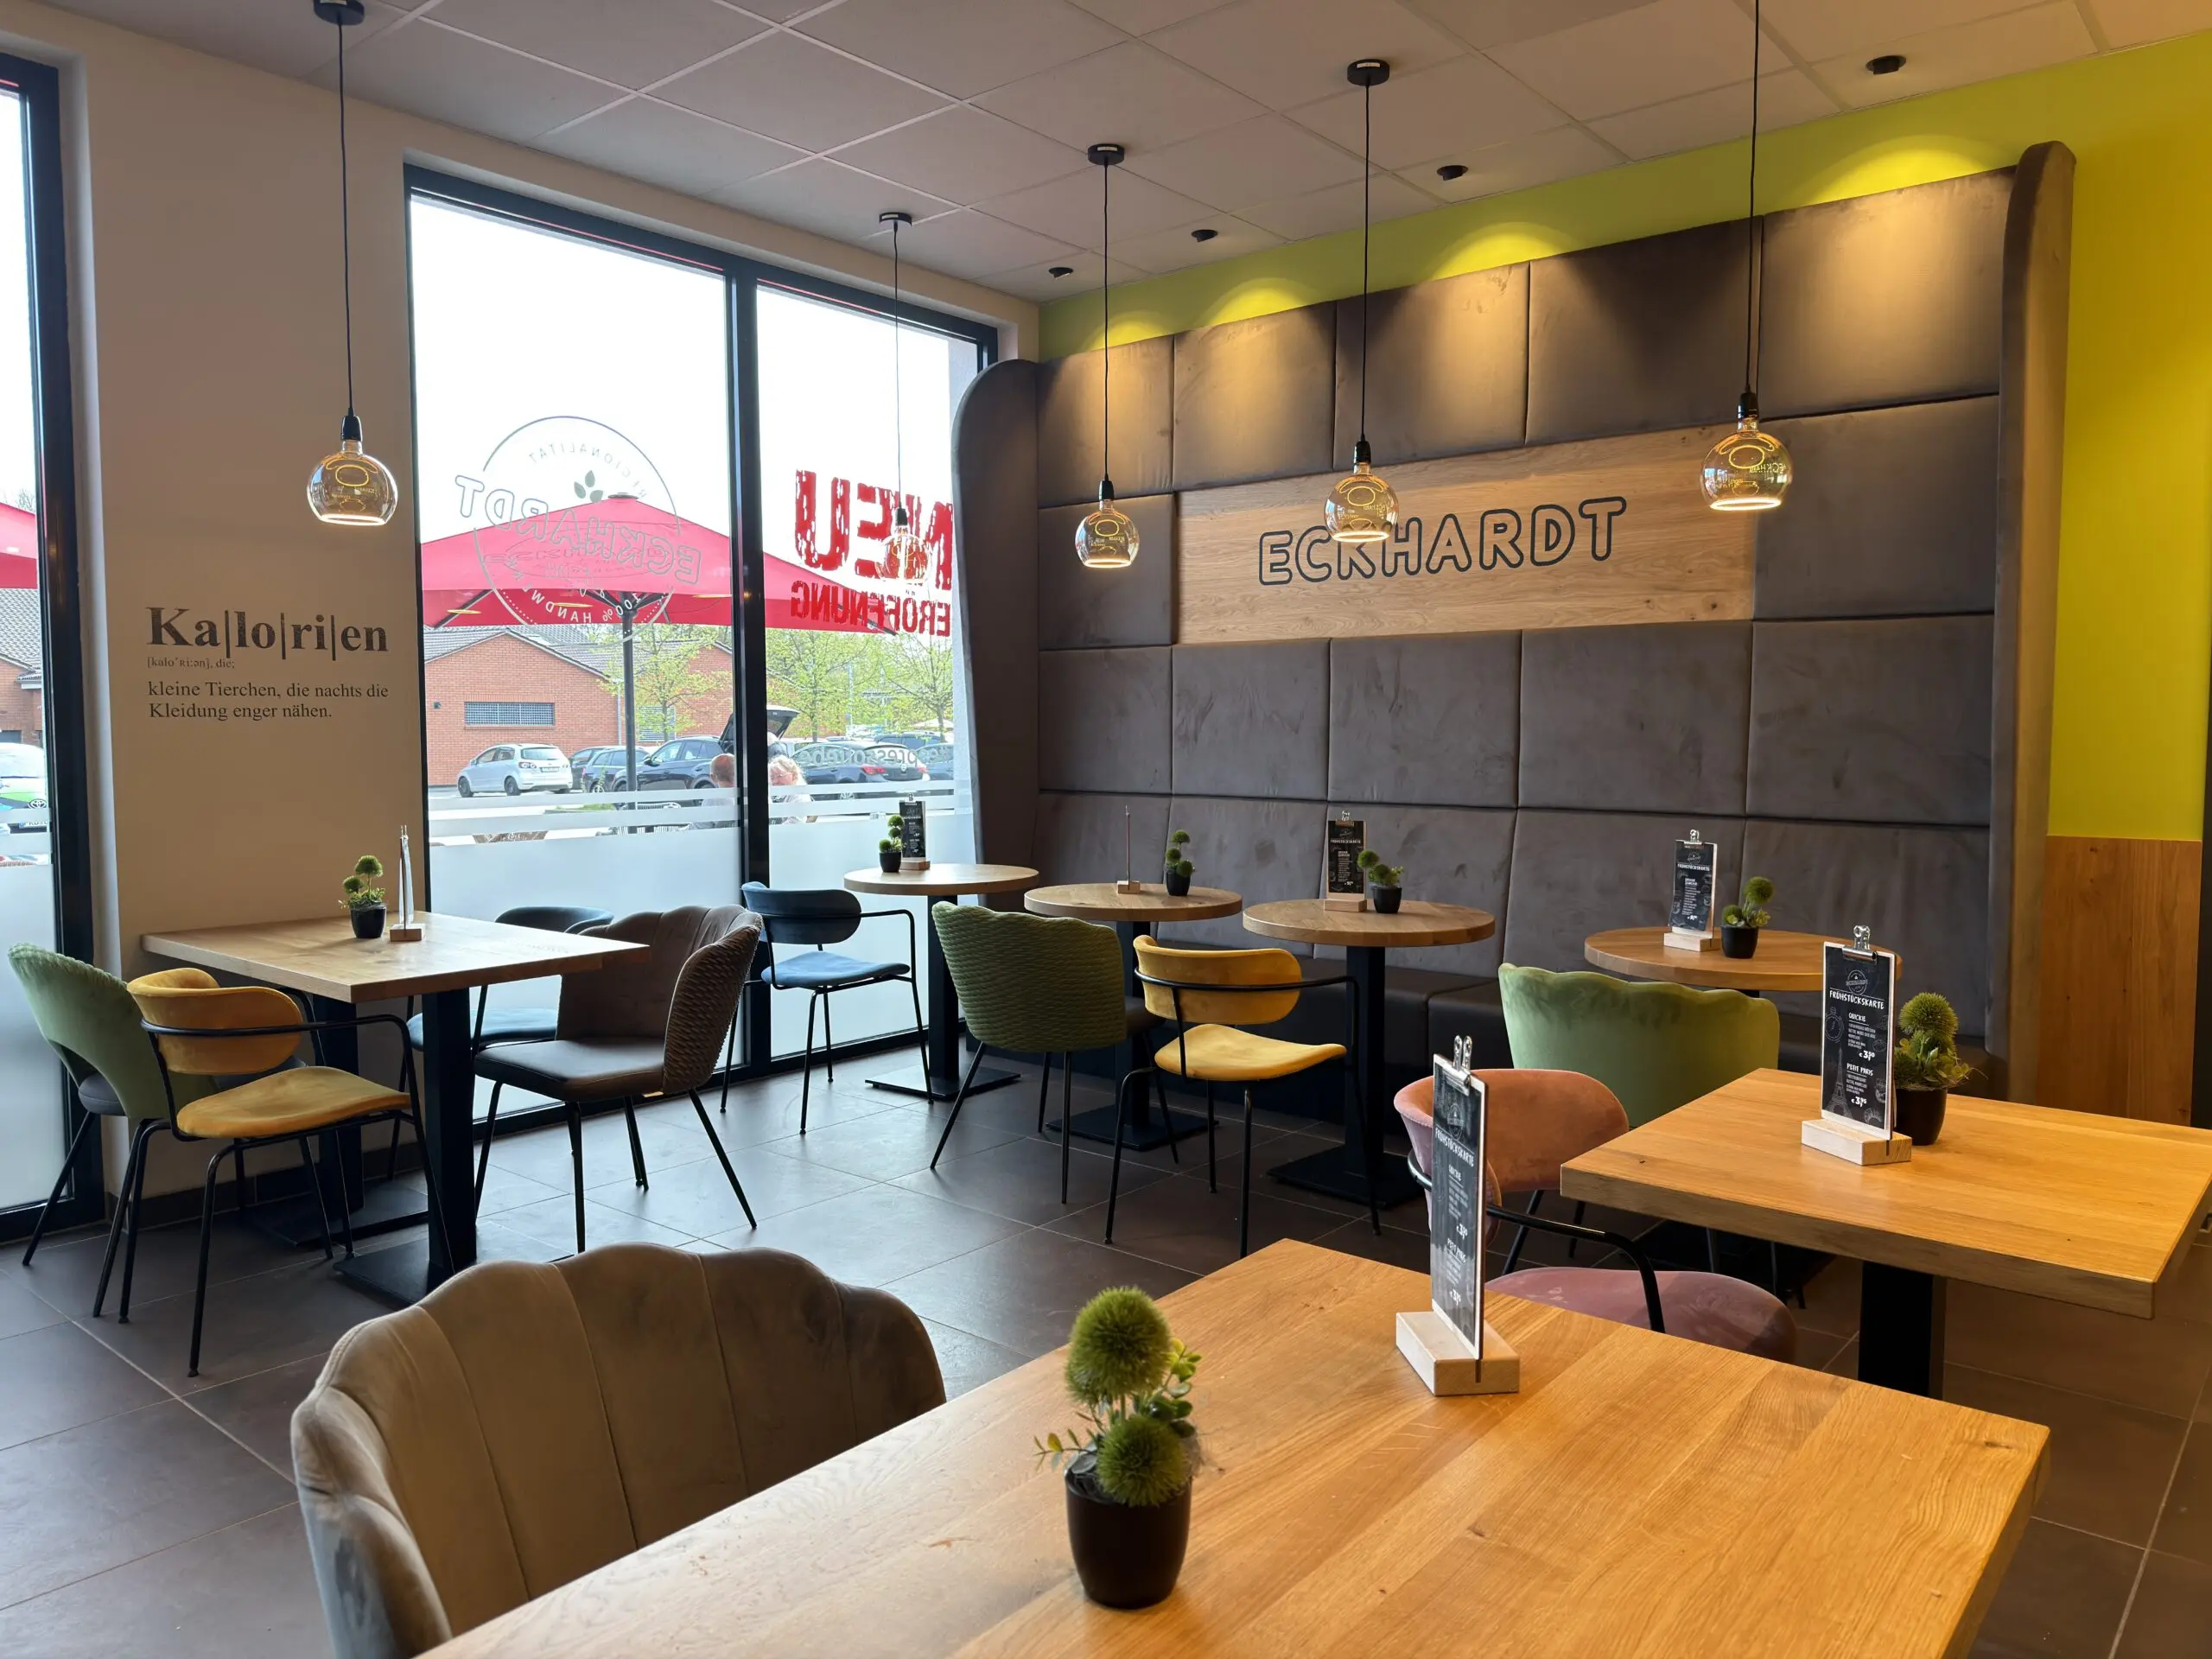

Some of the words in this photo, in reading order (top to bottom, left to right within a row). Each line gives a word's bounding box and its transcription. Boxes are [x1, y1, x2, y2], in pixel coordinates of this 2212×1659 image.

[1258, 495, 1628, 587] ECKHARDT
[148, 681, 200, 696] kleine
[205, 681, 282, 698] Tierchen,
[286, 683, 310, 697] die
[315, 683, 363, 697] nachts
[366, 683, 389, 697] die
[149, 702, 228, 721] Kleidung
[232, 706, 278, 721] enger
[283, 704, 333, 718] nähen.
[1829, 989, 1885, 1010] FRÜHSTÜCKSKARTE
[1847, 1063, 1859, 1072] PETIT
